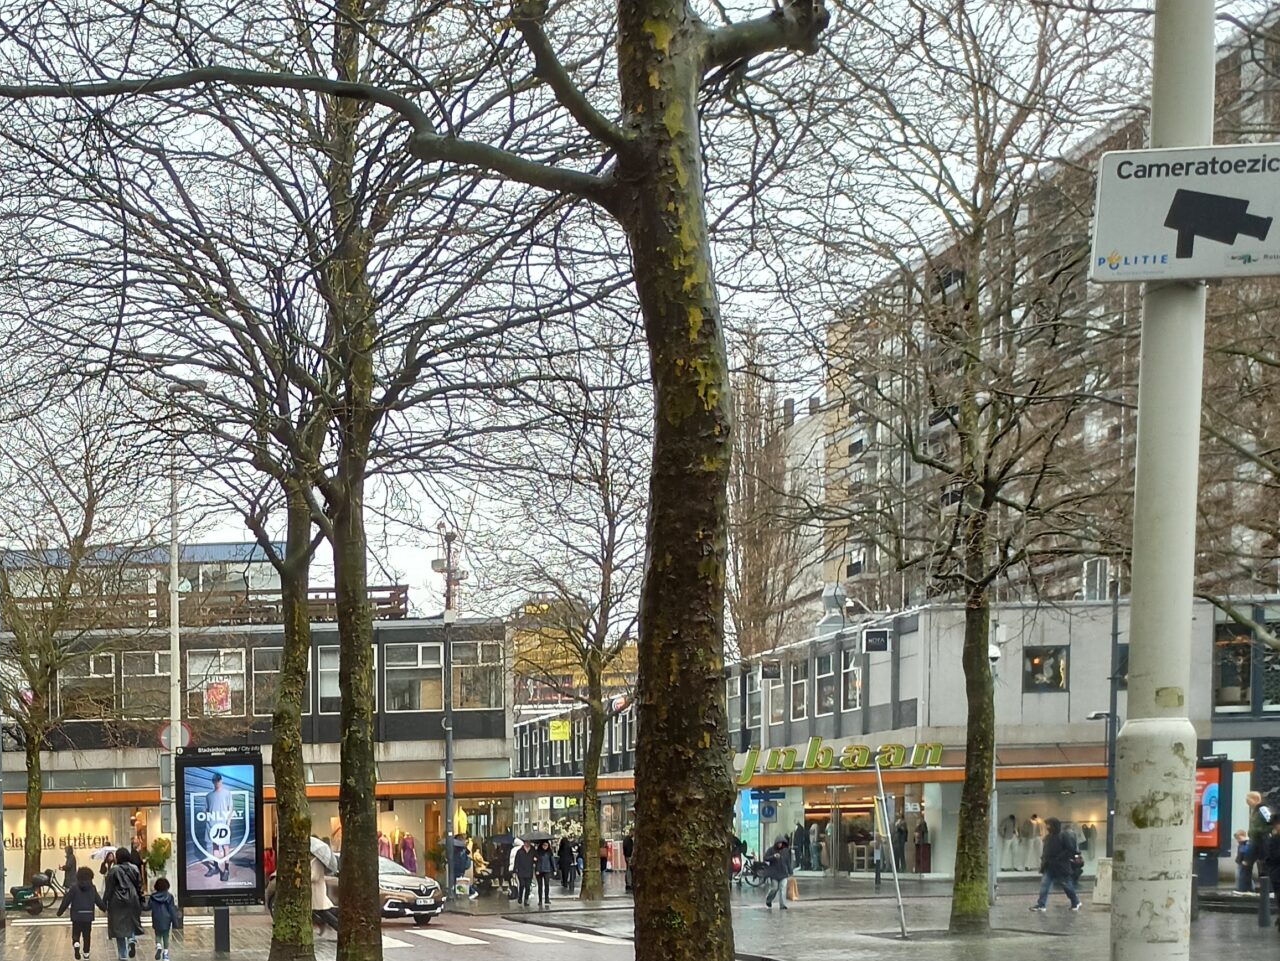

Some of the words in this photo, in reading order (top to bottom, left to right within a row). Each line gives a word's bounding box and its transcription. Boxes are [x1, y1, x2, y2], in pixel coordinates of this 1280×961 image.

[1097, 253, 1169, 271] POLITIE
[731, 736, 944, 785] jnbaan
[196, 810, 231, 822] ONLY
[4, 832, 55, 850] claia
[212, 828, 228, 839] JD
